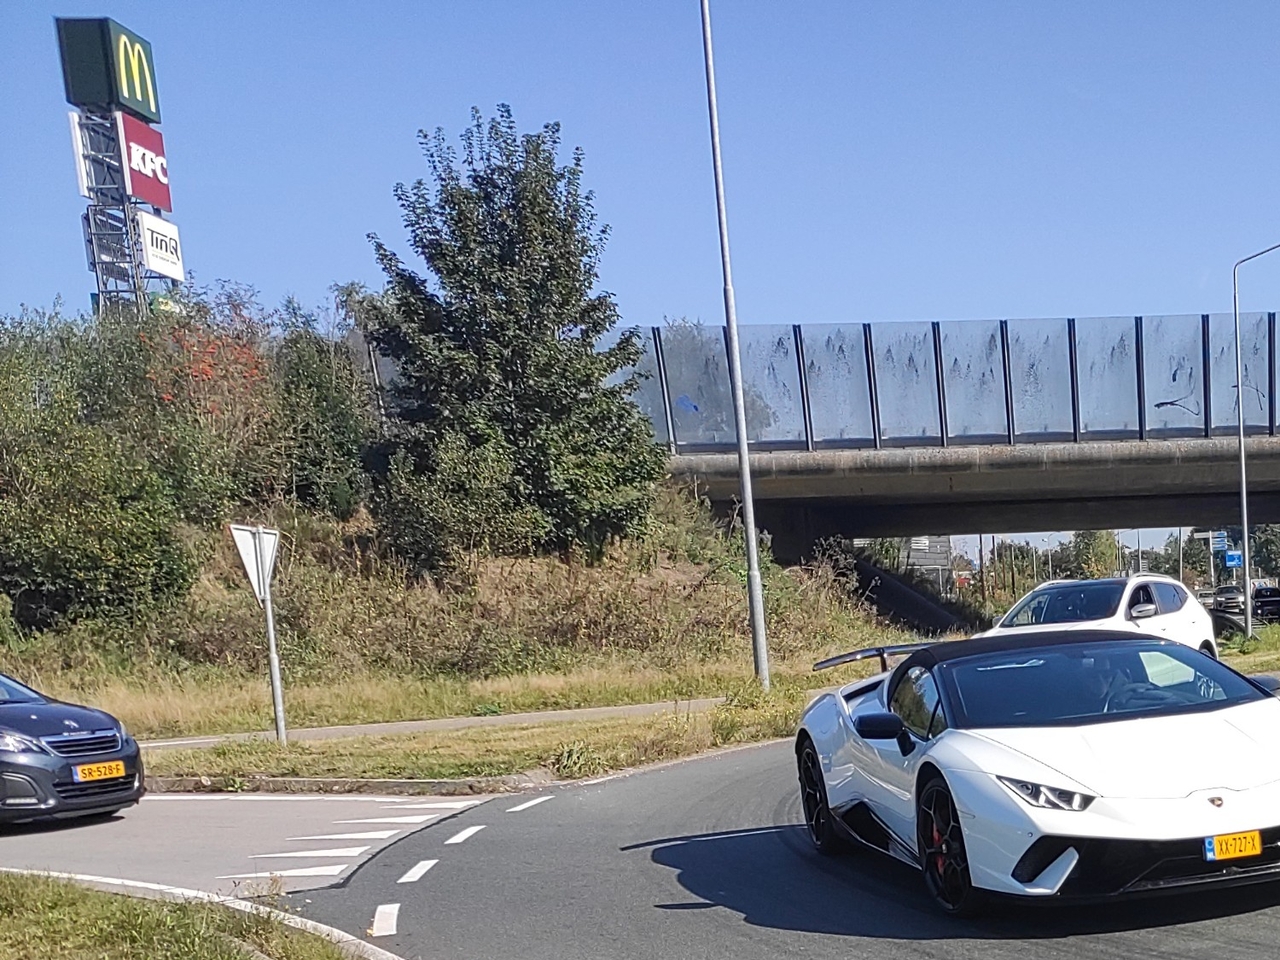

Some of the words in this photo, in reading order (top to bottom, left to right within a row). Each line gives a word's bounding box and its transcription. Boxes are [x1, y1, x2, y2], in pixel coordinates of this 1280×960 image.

[129, 142, 169, 184] KFC
[81, 763, 121, 779] SR-528-F
[1218, 835, 1257, 856] XX-727-X
